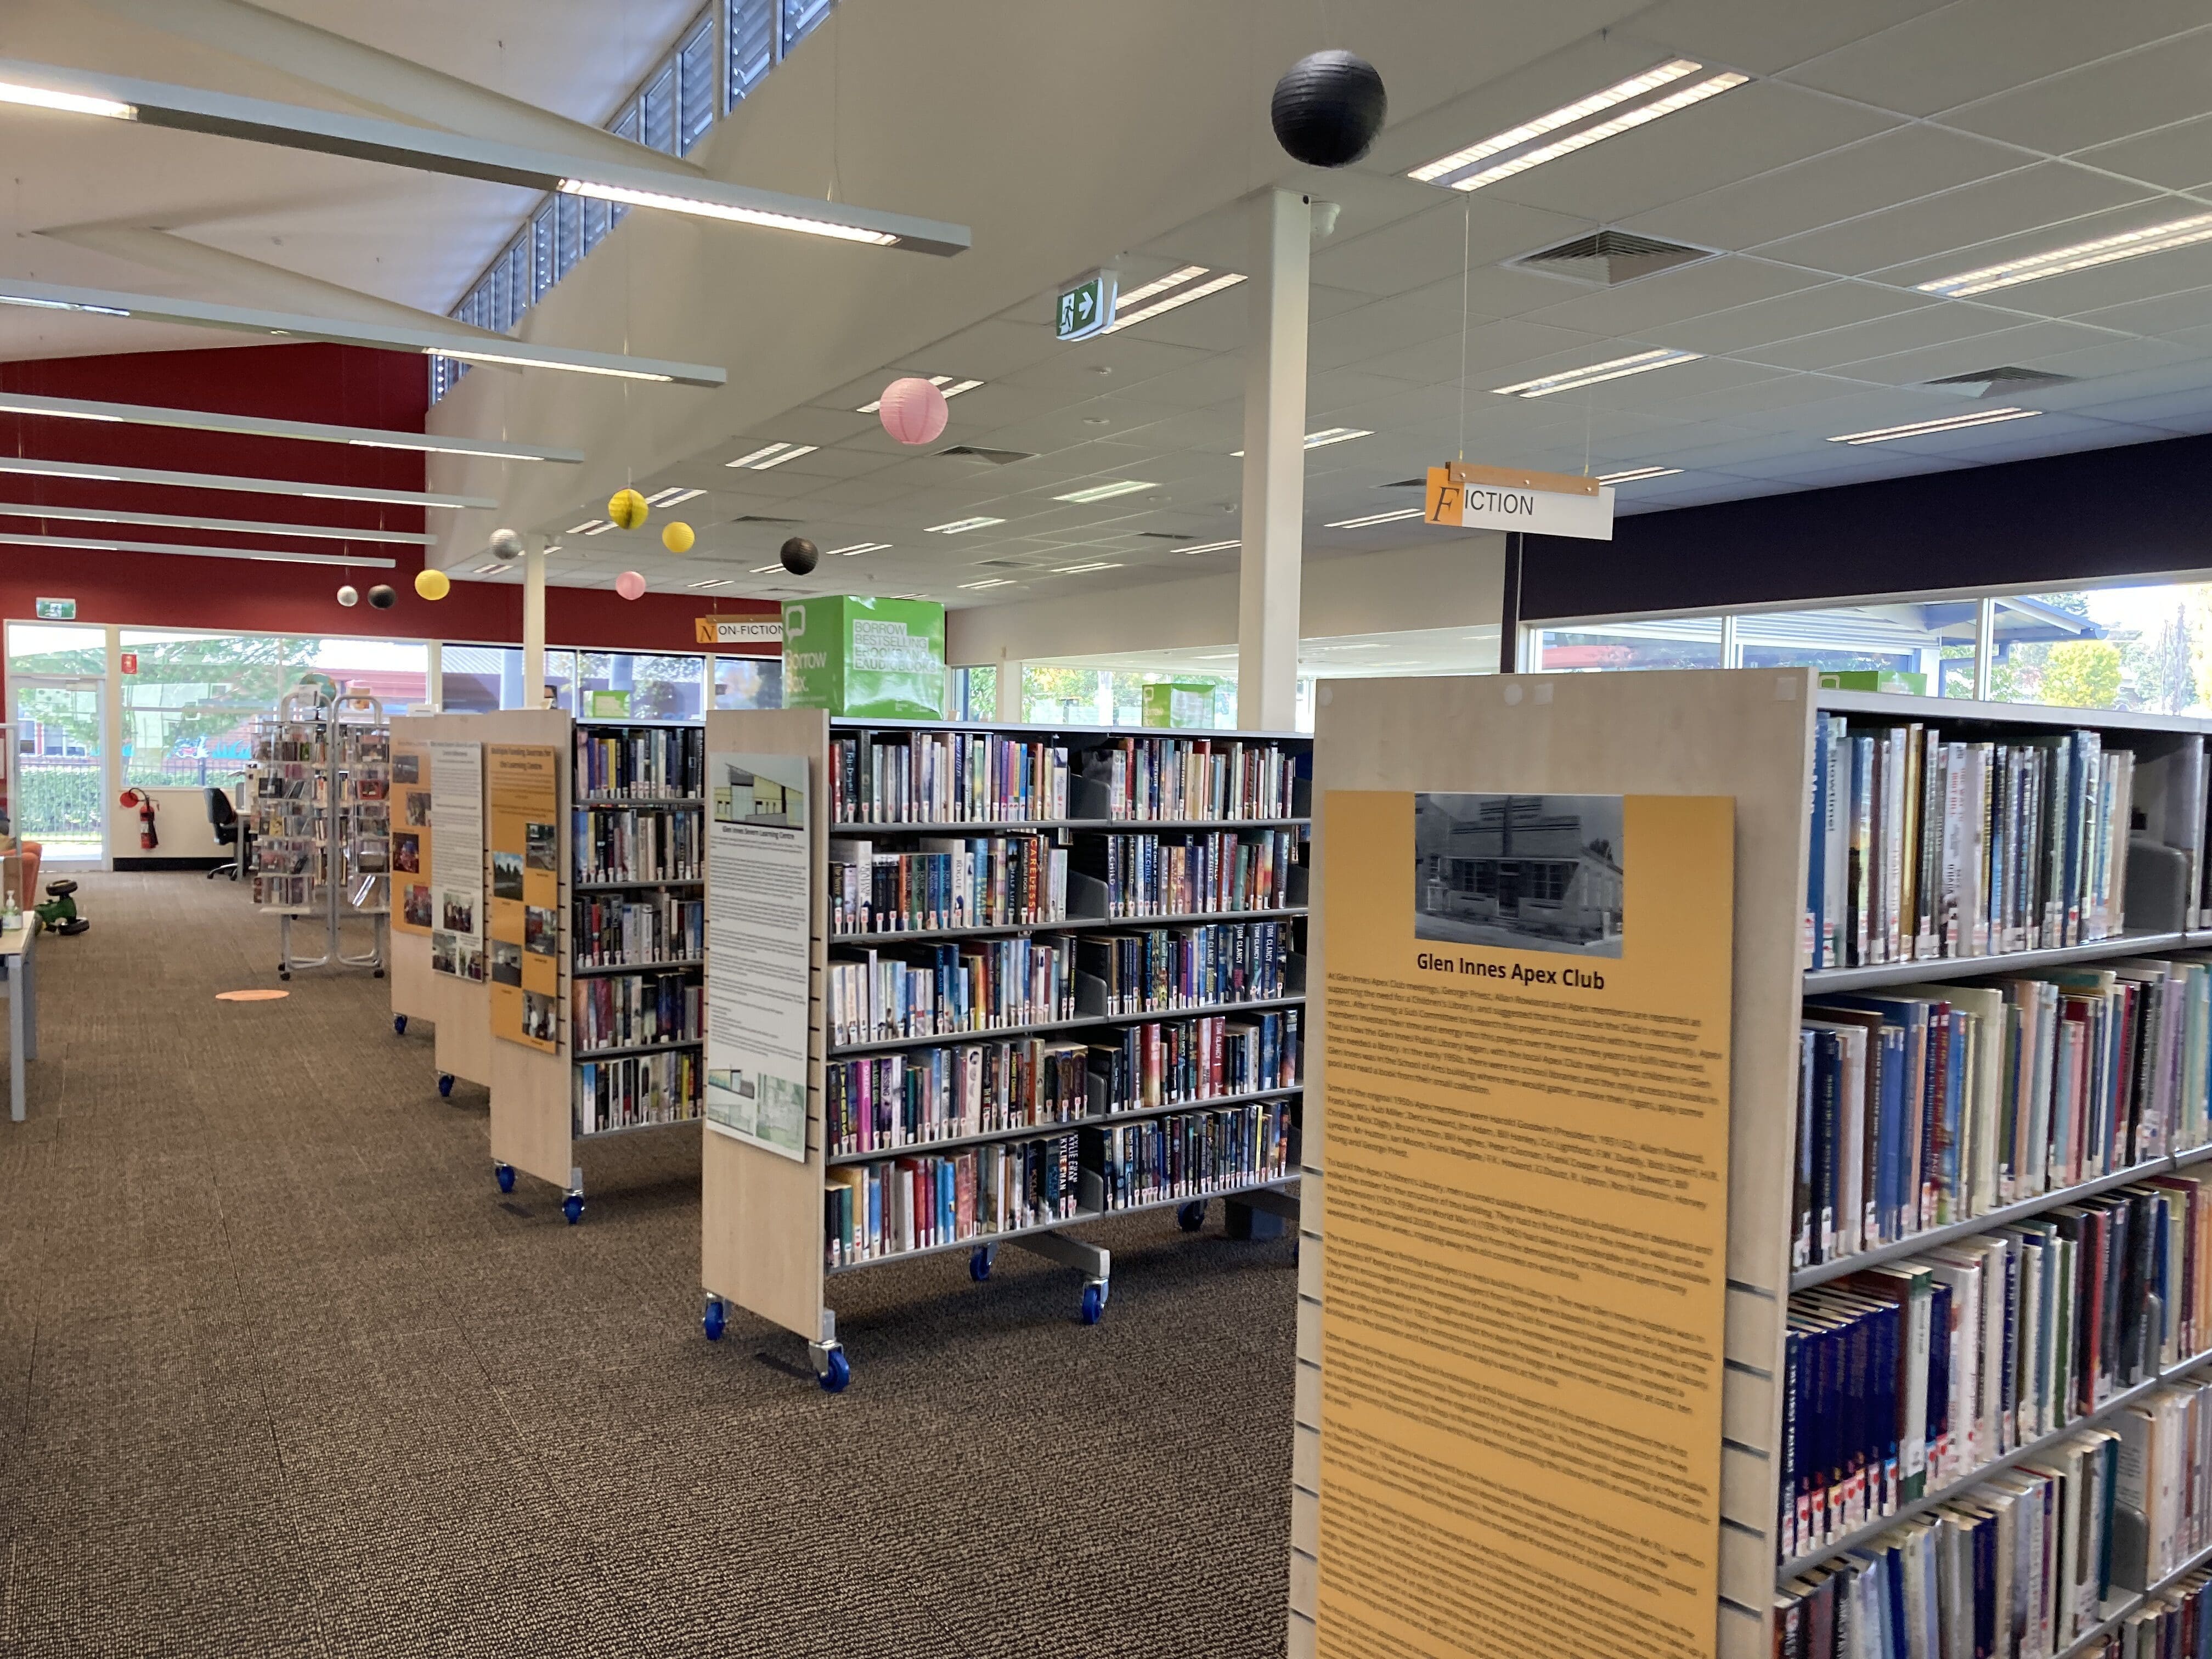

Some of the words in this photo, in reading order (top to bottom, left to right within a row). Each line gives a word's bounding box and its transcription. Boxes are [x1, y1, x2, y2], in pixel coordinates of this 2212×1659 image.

[1430, 487, 1534, 522] FICTION
[855, 622, 905, 635] BORROW
[855, 634, 927, 648] BESTSELLING
[786, 650, 827, 669] Borrow
[855, 647, 902, 658] EBOO
[1029, 839, 1037, 907] CARELESS
[1417, 952, 1454, 973] Glen
[1459, 956, 1506, 979] Innes
[1511, 962, 1557, 986] Apex
[1562, 968, 1605, 991] Club
